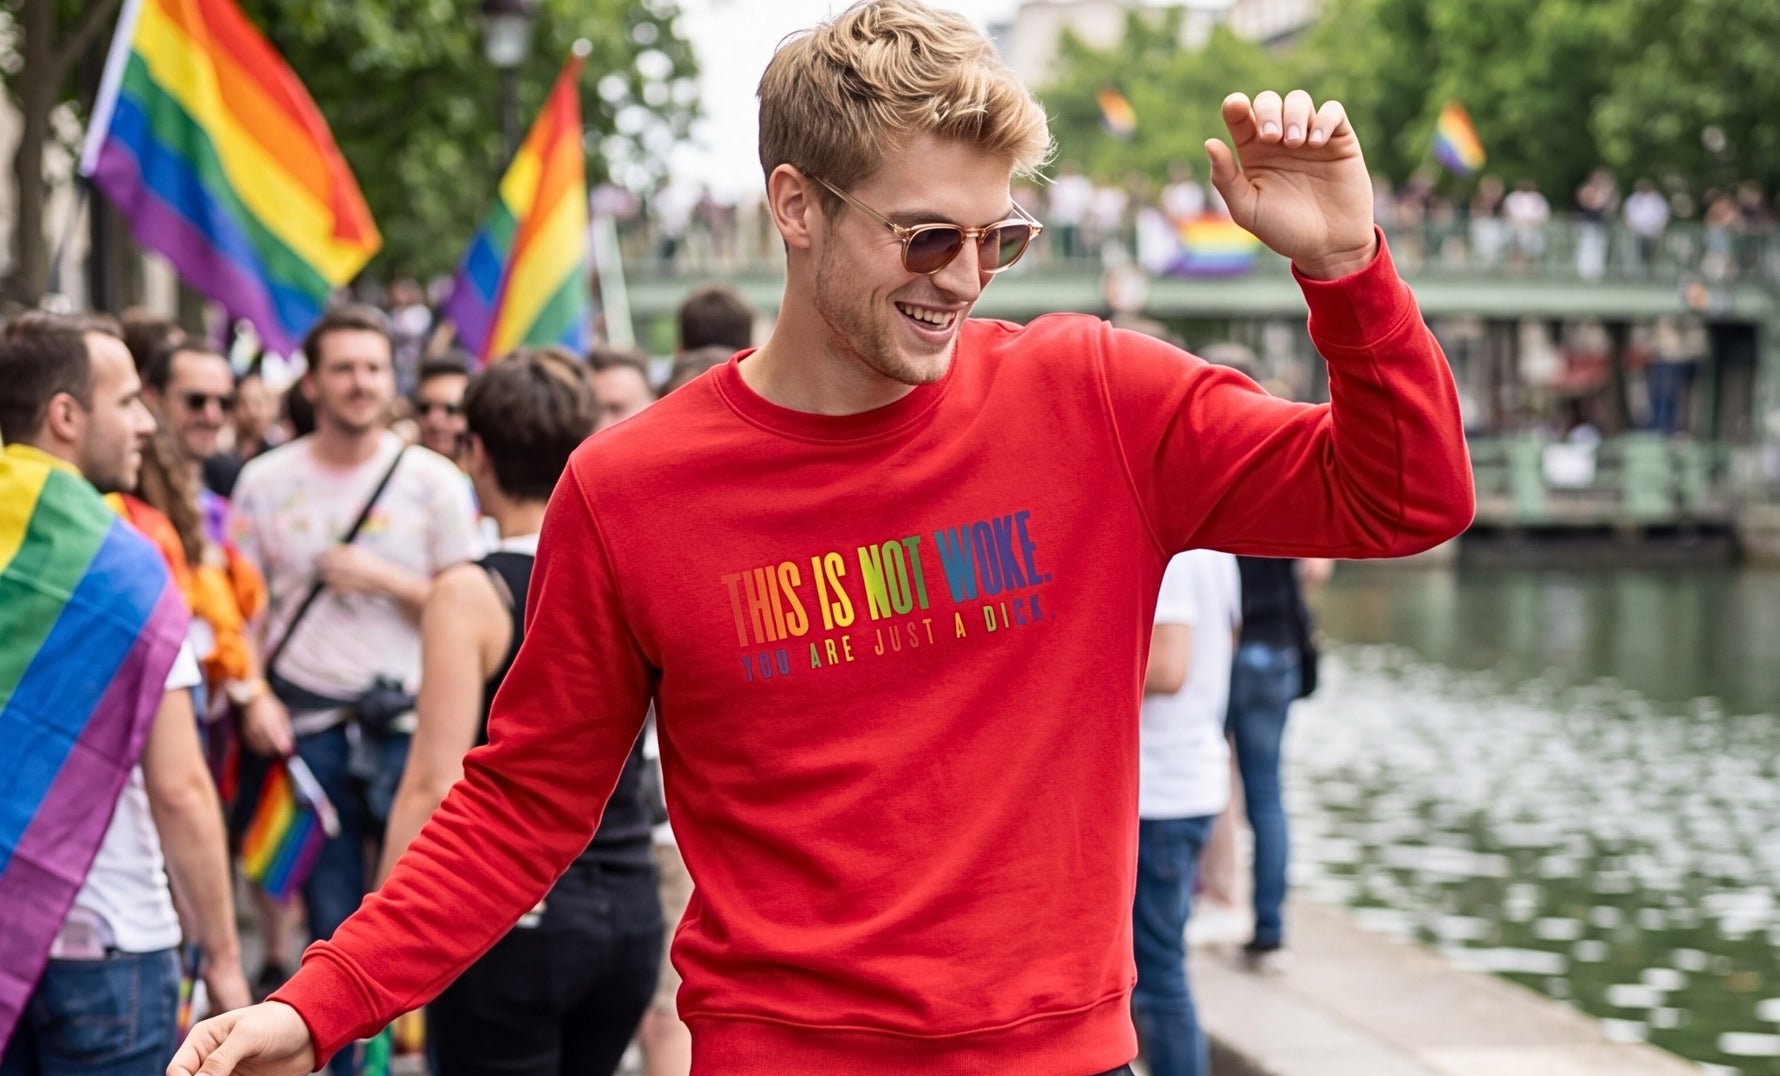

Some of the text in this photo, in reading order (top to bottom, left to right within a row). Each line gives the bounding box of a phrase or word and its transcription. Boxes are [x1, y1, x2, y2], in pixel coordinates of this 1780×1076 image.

[721, 510, 1053, 647] THIS IS NOT WOKE.
[740, 647, 790, 682] YOU
[810, 634, 854, 669] ARE
[874, 618, 934, 656] JUST
[955, 612, 967, 639] A
